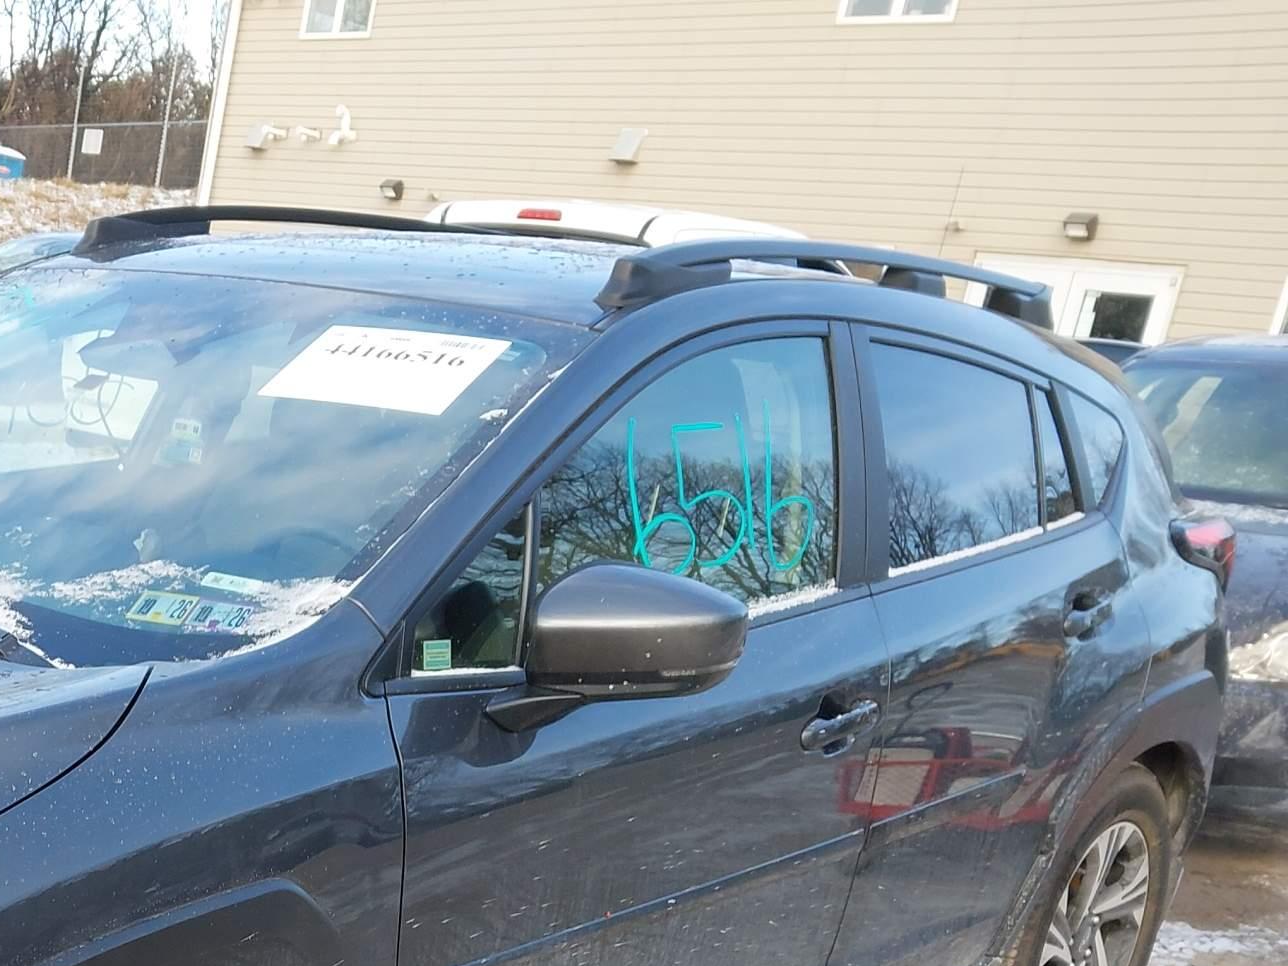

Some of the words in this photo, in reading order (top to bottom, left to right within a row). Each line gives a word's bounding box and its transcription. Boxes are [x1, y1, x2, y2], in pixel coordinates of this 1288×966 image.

[325, 343, 465, 367] 44166516
[169, 599, 193, 622] 26
[227, 607, 251, 629] 26
